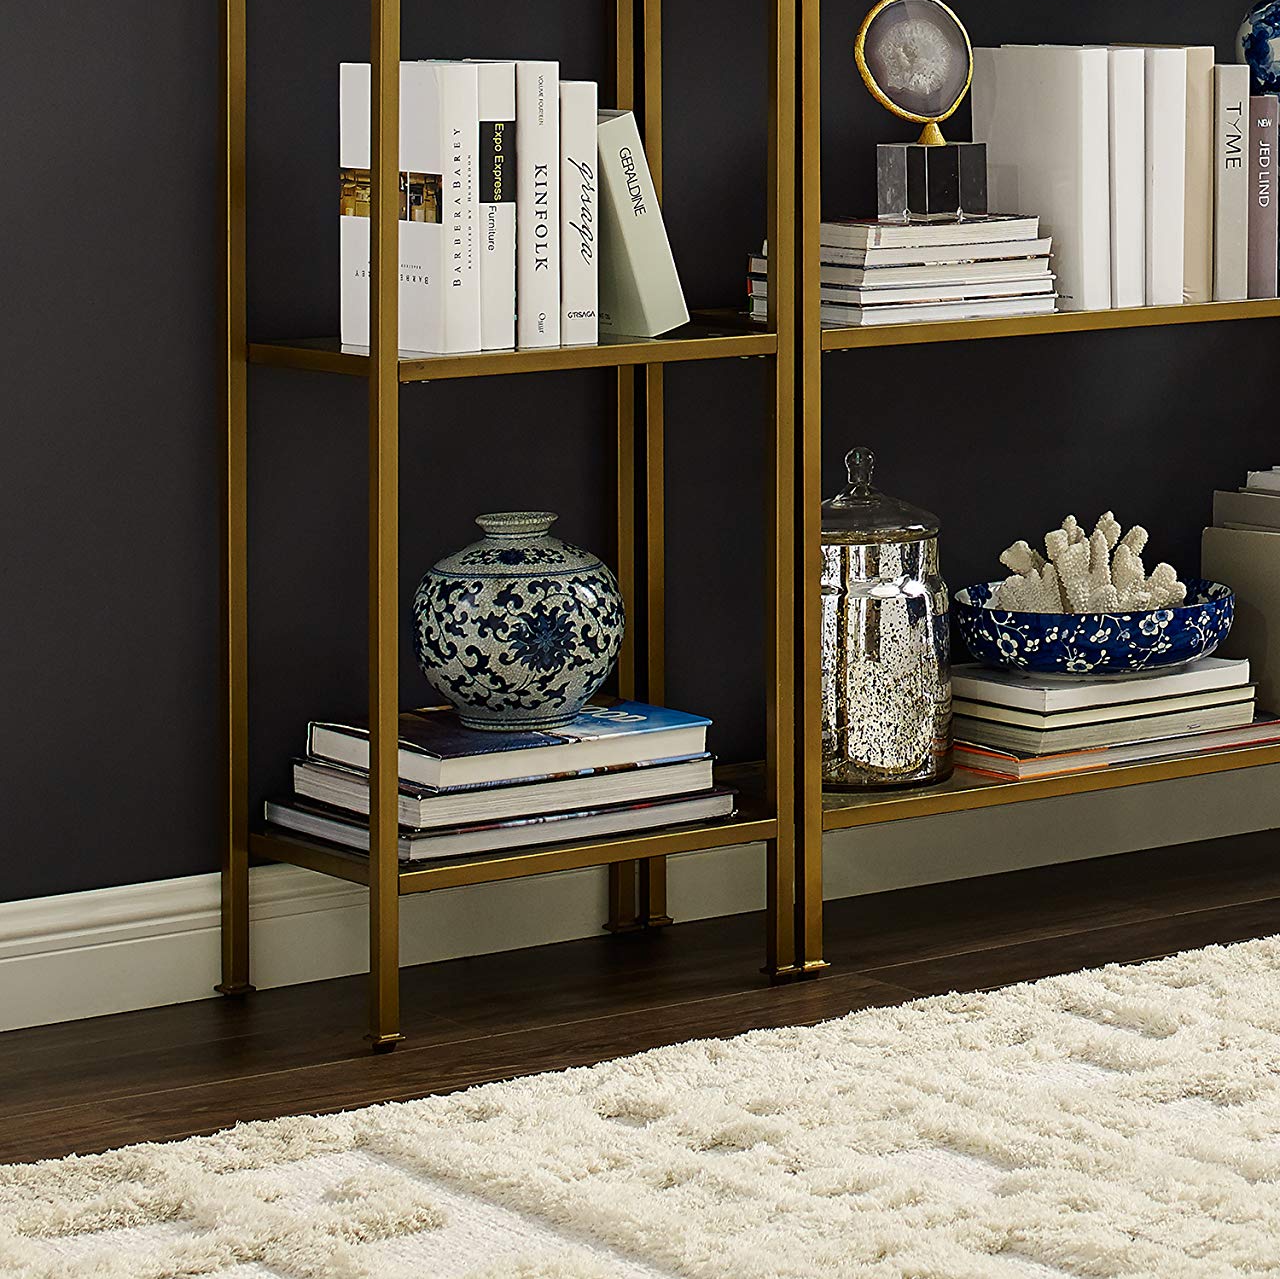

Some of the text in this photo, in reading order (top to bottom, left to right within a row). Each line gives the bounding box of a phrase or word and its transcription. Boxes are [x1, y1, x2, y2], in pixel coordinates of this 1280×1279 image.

[1225, 101, 1243, 170] TYME
[1257, 118, 1273, 127] NEW
[493, 122, 505, 201] Expo Express
[619, 146, 647, 217] GERALDINE
[1258, 140, 1271, 208] JED LIND
[487, 205, 498, 251] Furniture
[534, 163, 549, 272] KINFOLK
[578, 705, 648, 723] OOD
